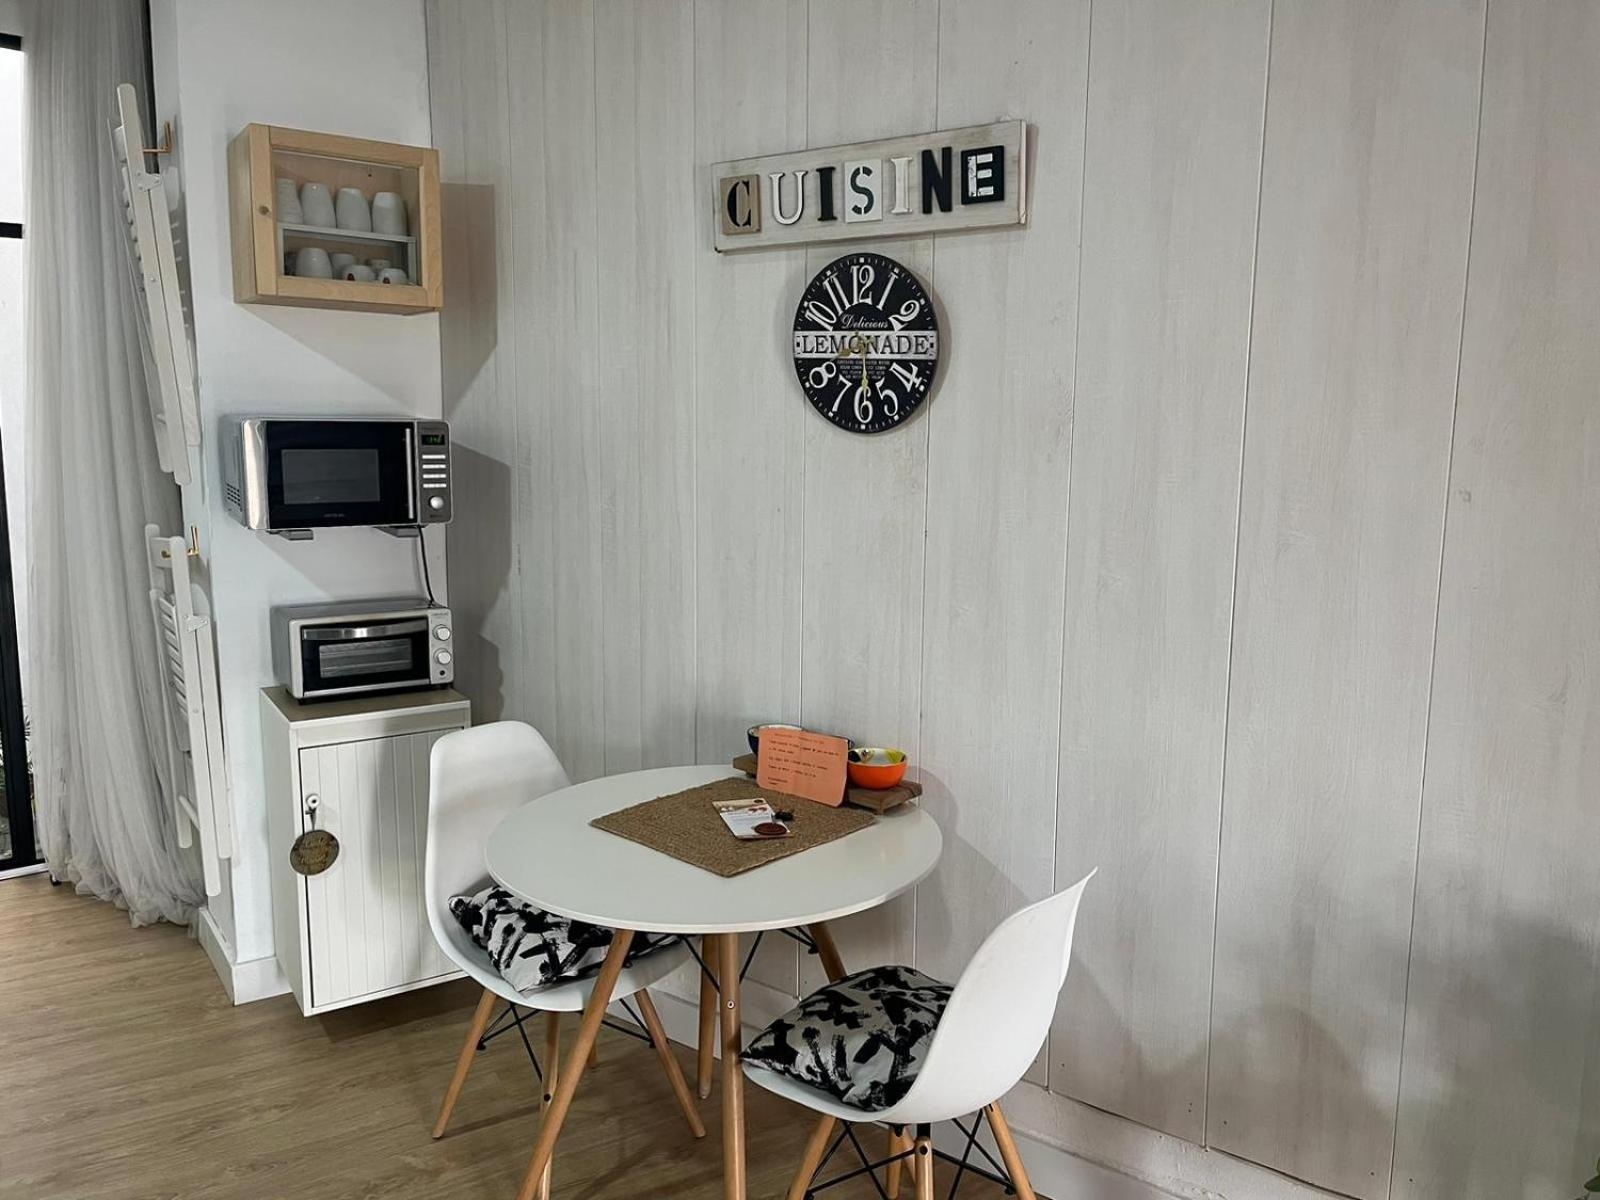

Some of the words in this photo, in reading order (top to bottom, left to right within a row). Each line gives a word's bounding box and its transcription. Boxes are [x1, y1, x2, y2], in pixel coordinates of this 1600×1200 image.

[727, 147, 995, 227] CUISINE
[823, 272, 852, 316] 11
[850, 265, 875, 306] 12
[876, 272, 900, 311] 1
[805, 301, 837, 331] 10
[841, 313, 889, 329] Delicious
[888, 300, 920, 332] 2
[801, 335, 930, 355] LEMONADE
[809, 361, 837, 388] 8
[832, 374, 853, 412] 7
[888, 362, 922, 393] 4
[853, 384, 873, 423] 6
[875, 377, 899, 416] 5
